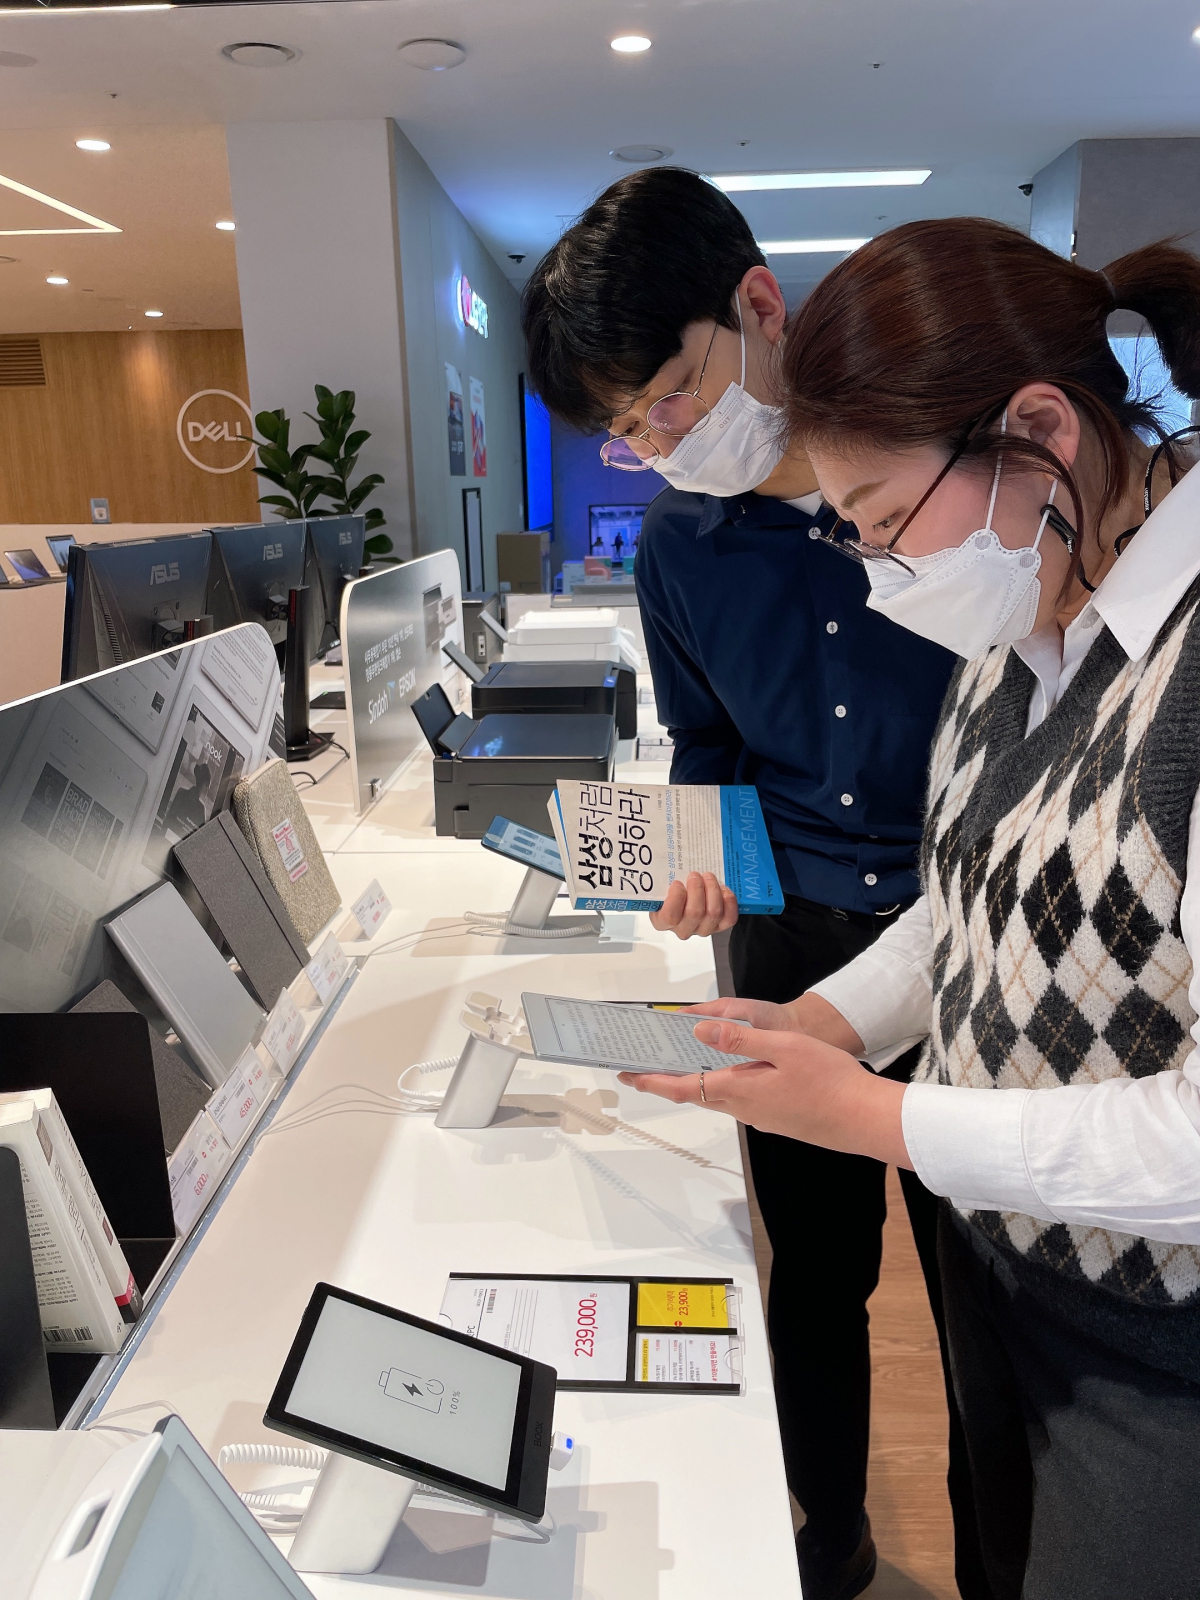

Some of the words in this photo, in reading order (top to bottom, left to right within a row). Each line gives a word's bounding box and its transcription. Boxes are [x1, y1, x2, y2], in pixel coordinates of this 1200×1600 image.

[187, 421, 247, 442] DELL
[339, 531, 353, 545] ASUS
[263, 543, 284, 561] ASUS
[150, 562, 180, 585] ASUS
[398, 667, 416, 698] EPSON
[368, 691, 389, 725] Sindoh
[204, 741, 223, 763] nook
[65, 789, 88, 813] BRAD
[62, 802, 83, 827] THOR
[54, 819, 77, 841] BLACK
[578, 782, 613, 890] 삼성처럼
[618, 788, 653, 895] 경영하라
[739, 788, 761, 900] MANAGEMENT
[584, 900, 629, 911] 삼성처럼
[630, 901, 662, 911] 경영하
[449, 1390, 461, 1415] 100%
[534, 1421, 543, 1447] BOOX
